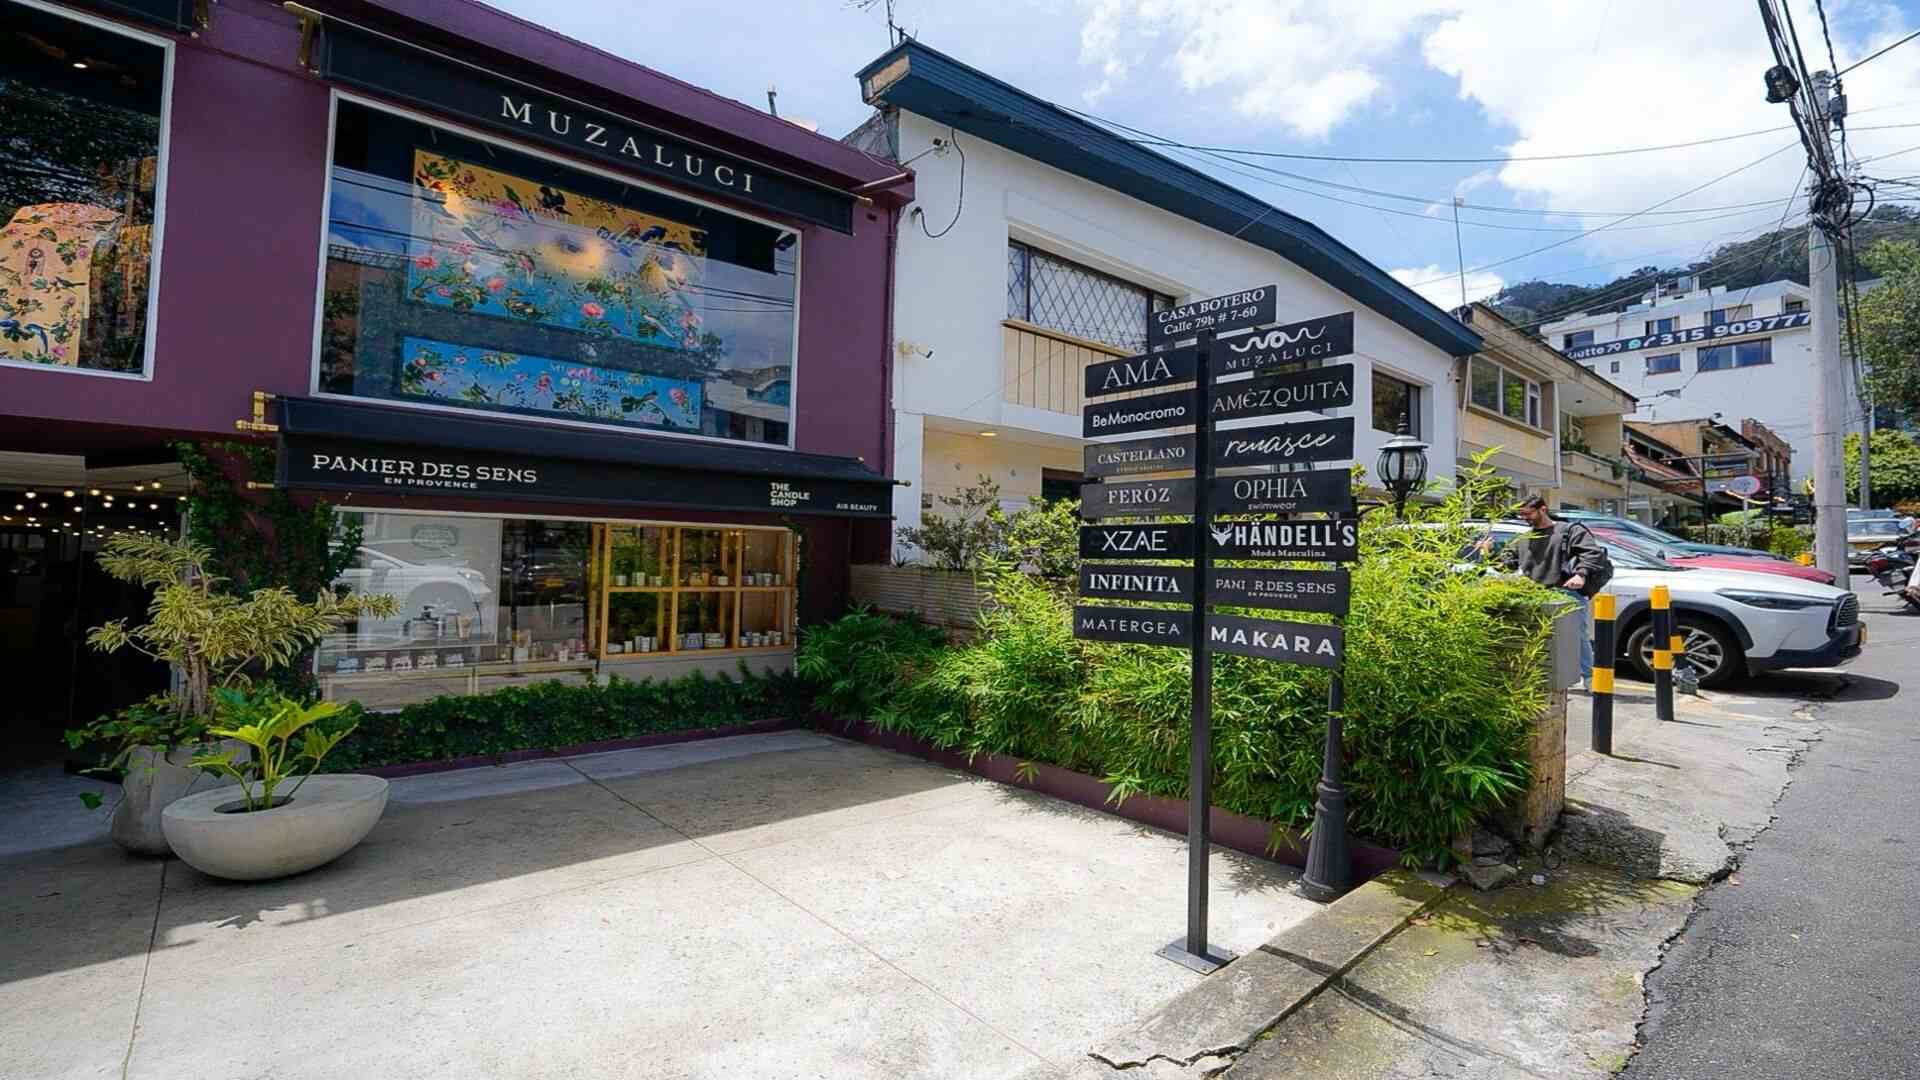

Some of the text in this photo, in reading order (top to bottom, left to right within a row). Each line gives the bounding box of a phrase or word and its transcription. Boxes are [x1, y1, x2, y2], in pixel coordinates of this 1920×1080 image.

[501, 95, 753, 192] MUZALUCI
[1158, 289, 1265, 323] CASA BOTERO
[1163, 322, 1192, 335] Calle
[1217, 312, 1227, 323] #
[1230, 305, 1257, 321] 7-60
[1660, 328, 1705, 345] 315
[1225, 342, 1333, 369] MUZALUCI
[1103, 357, 1173, 389] AMA
[1091, 405, 1186, 428] BeMonocromo
[1097, 446, 1185, 464] CASTELLANO
[311, 454, 537, 483] PANIER DES SENS
[384, 477, 478, 489] EN PROVENCE
[770, 482, 790, 491] THE
[1233, 477, 1308, 500] OPHIA
[770, 491, 810, 500] CANDLE
[770, 498, 798, 507] SHOP
[1247, 501, 1297, 510] swimwear
[1102, 530, 1168, 551] XZAE
[1089, 574, 1181, 593] INFINITA
[1266, 581, 1294, 593] DES
[1296, 582, 1337, 594] SENS
[1081, 618, 1181, 635] MATERGEA
[1210, 626, 1336, 656] MAKARA
